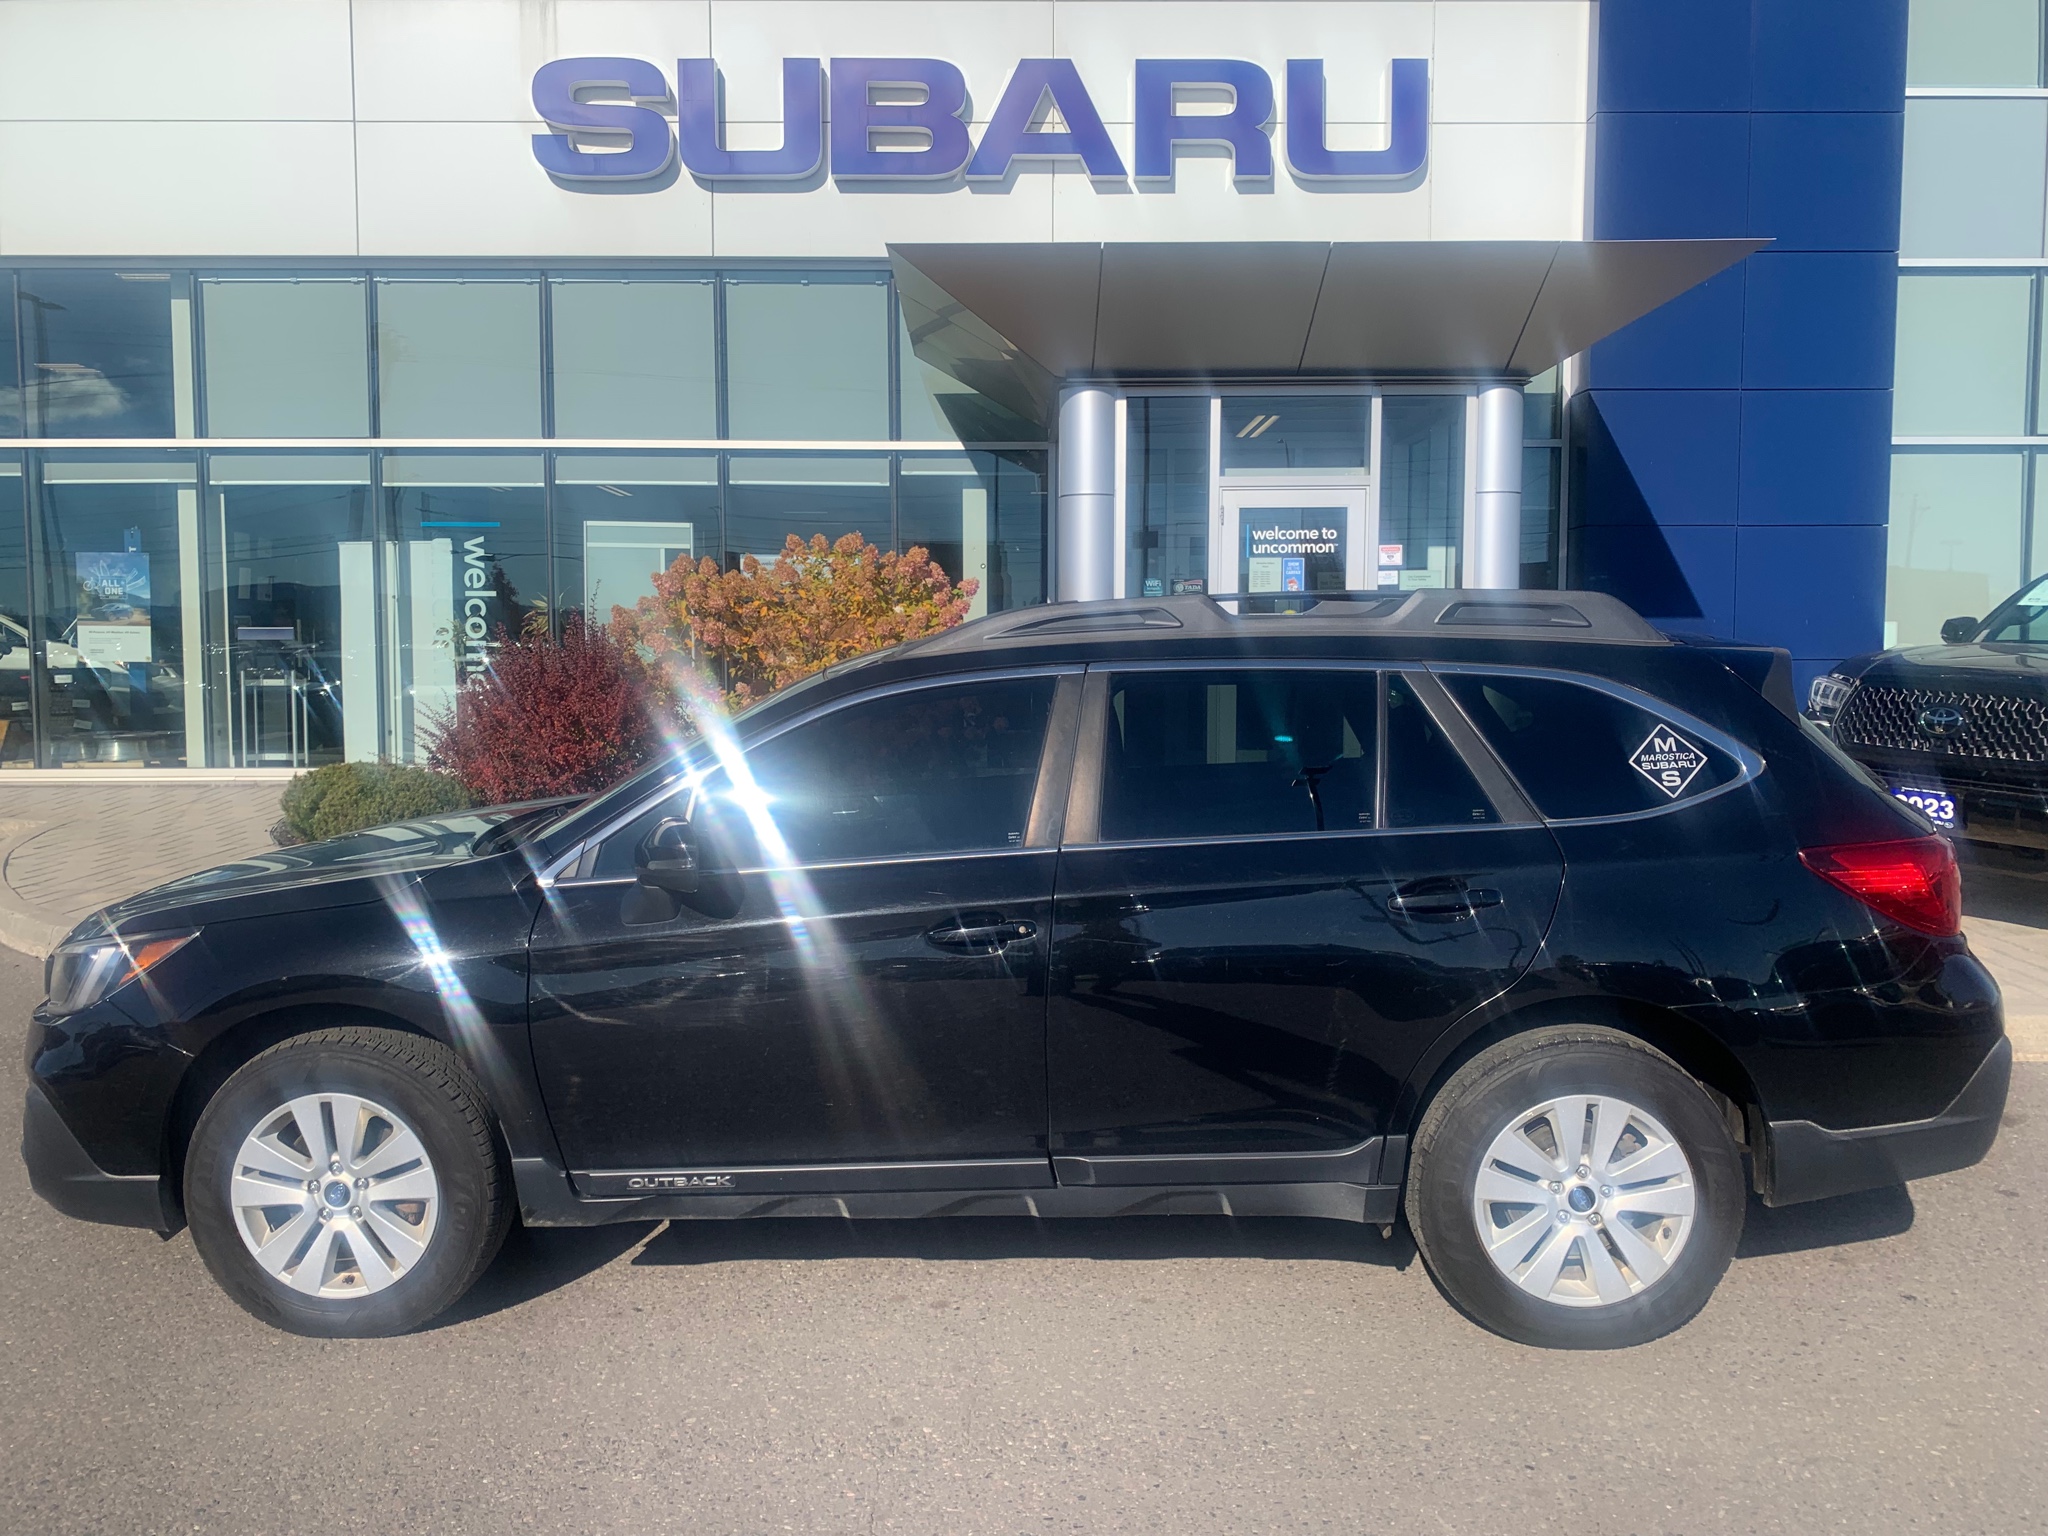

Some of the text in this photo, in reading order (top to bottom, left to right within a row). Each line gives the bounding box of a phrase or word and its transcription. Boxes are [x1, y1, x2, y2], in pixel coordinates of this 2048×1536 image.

[532, 57, 1429, 178] SUBARU
[1252, 526, 1337, 540] welcome to
[101, 579, 120, 587] ALL
[104, 587, 124, 595] ONE
[1653, 737, 1677, 753] M
[1640, 752, 1696, 762] MAROSTICA
[1641, 760, 1697, 770] SUBARU
[1661, 770, 1682, 787] S
[1895, 794, 1955, 820] 023
[628, 1175, 732, 1188] OUTBACK
